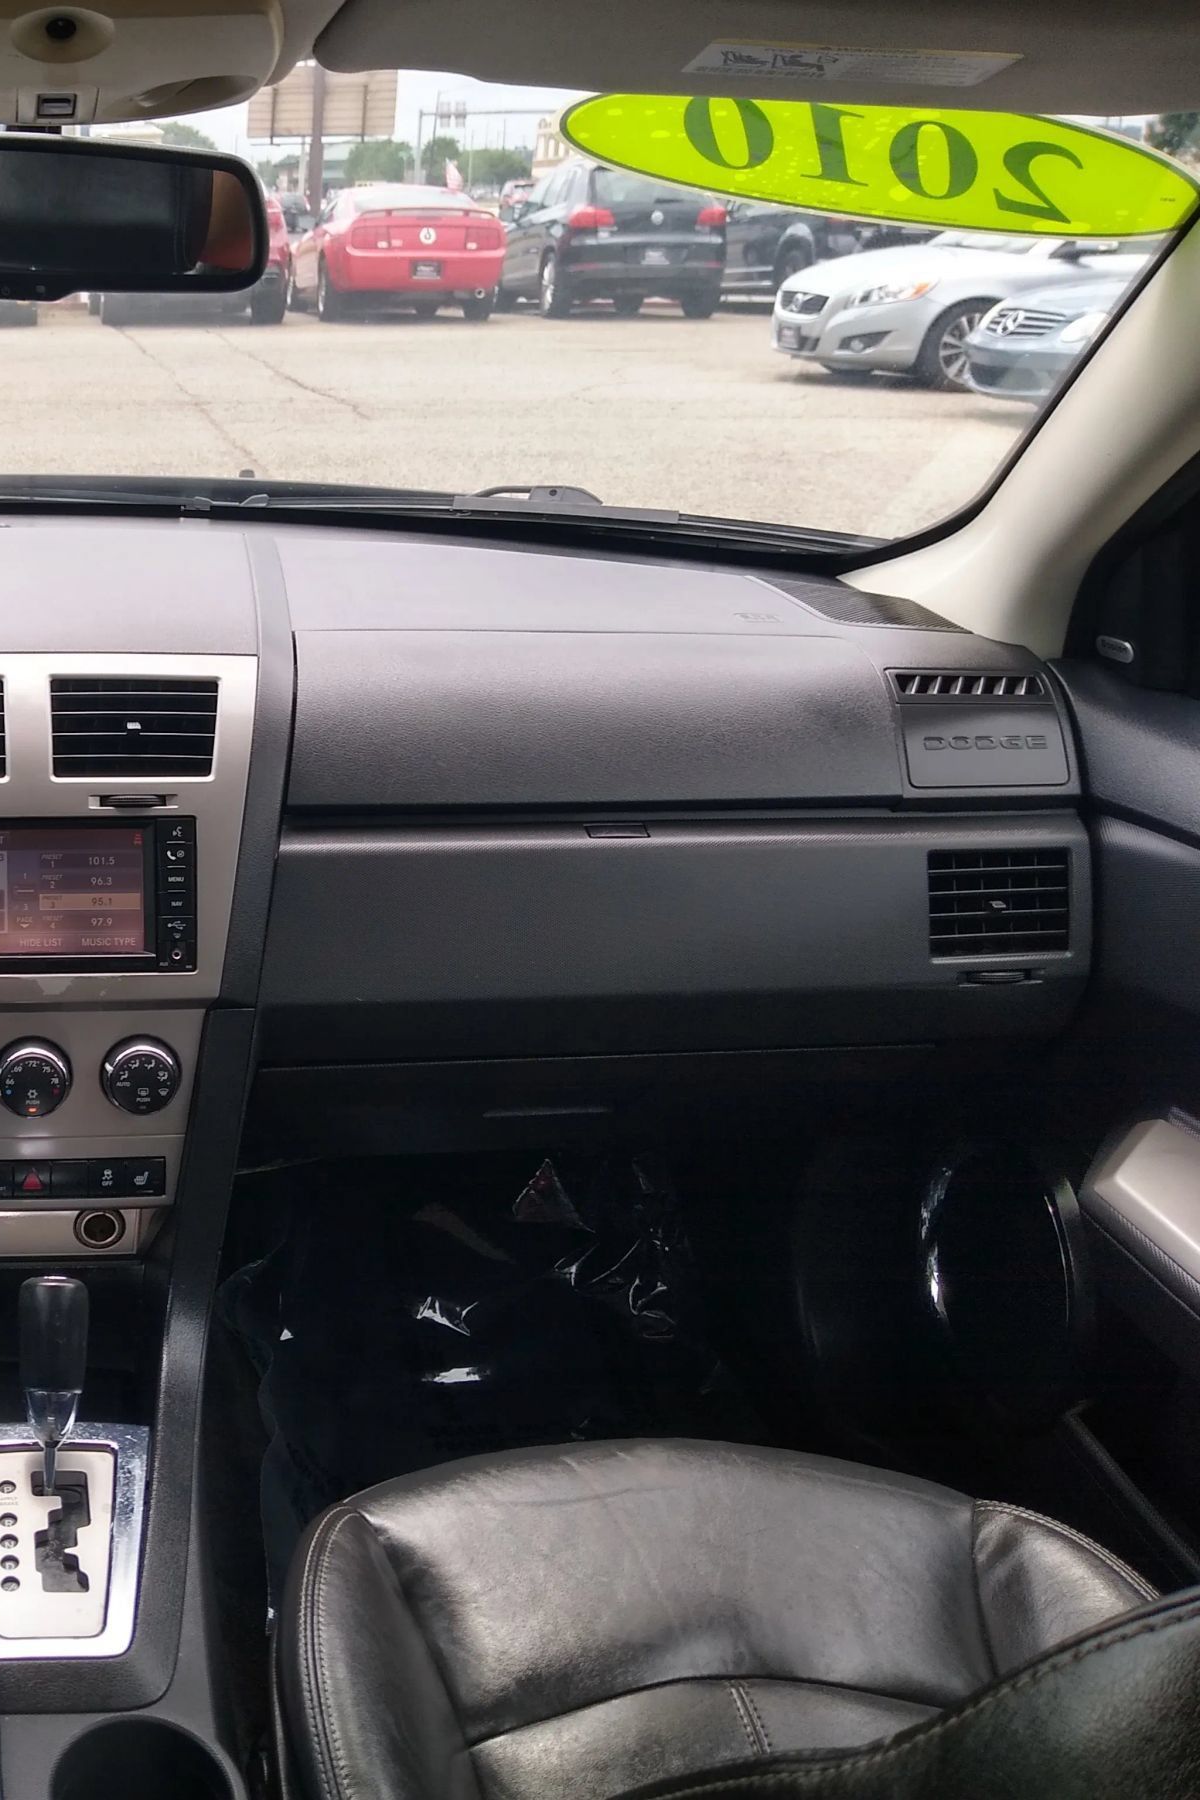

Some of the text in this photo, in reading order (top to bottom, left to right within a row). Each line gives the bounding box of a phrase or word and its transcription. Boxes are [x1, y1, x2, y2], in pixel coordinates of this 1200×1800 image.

[923, 735, 1048, 750] DODGE
[88, 856, 115, 865] 101.5
[50, 881, 55, 889] 2
[91, 876, 113, 886] 96.3
[91, 897, 113, 906] 95.1
[90, 917, 113, 927] 97.9
[19, 938, 63, 947] HIDE LIST
[82, 938, 136, 946] MUSIC TYPE
[3, 1486, 11, 1494] P
